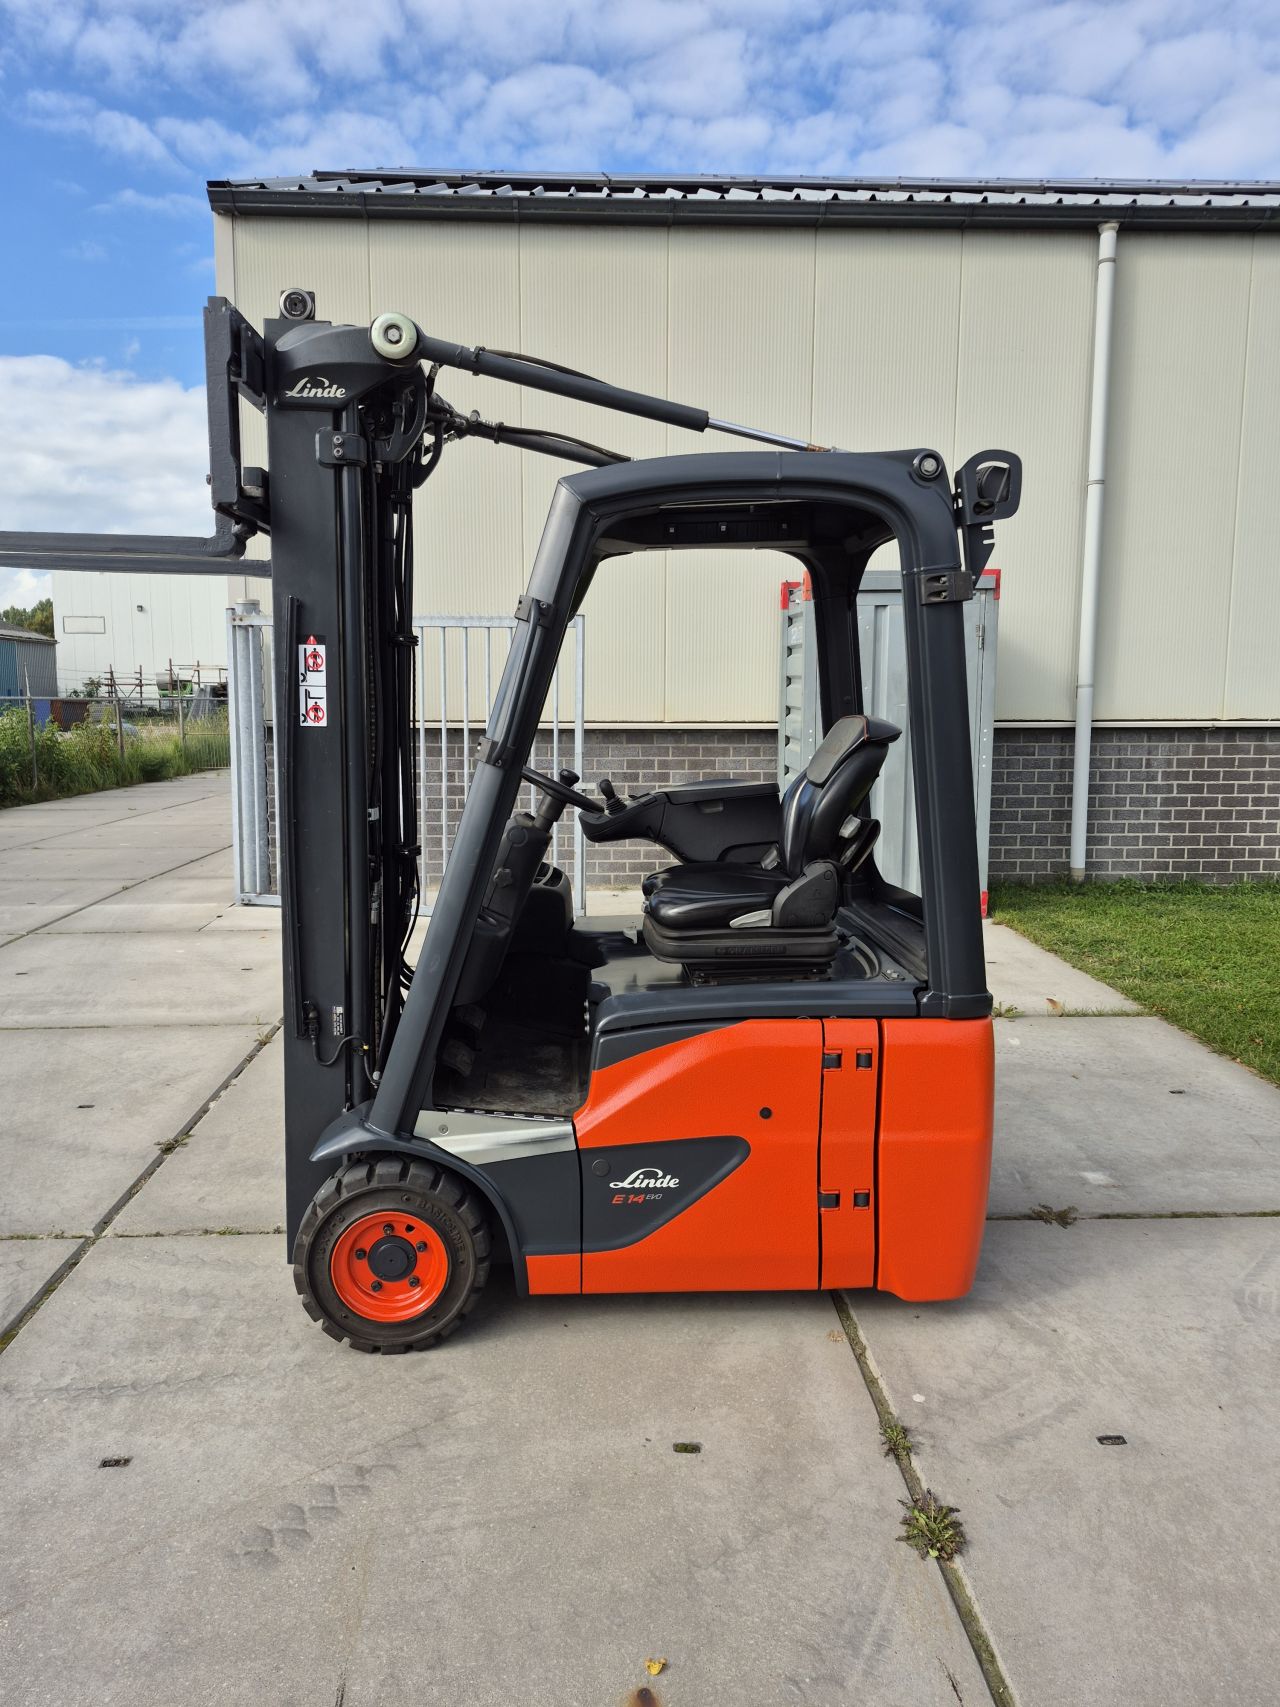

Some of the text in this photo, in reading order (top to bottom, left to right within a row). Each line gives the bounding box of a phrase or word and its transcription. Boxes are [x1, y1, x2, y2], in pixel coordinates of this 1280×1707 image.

[285, 376, 346, 398] Linde
[609, 1168, 680, 1189] Linde
[612, 1194, 626, 1204] E
[628, 1194, 646, 1204] 14
